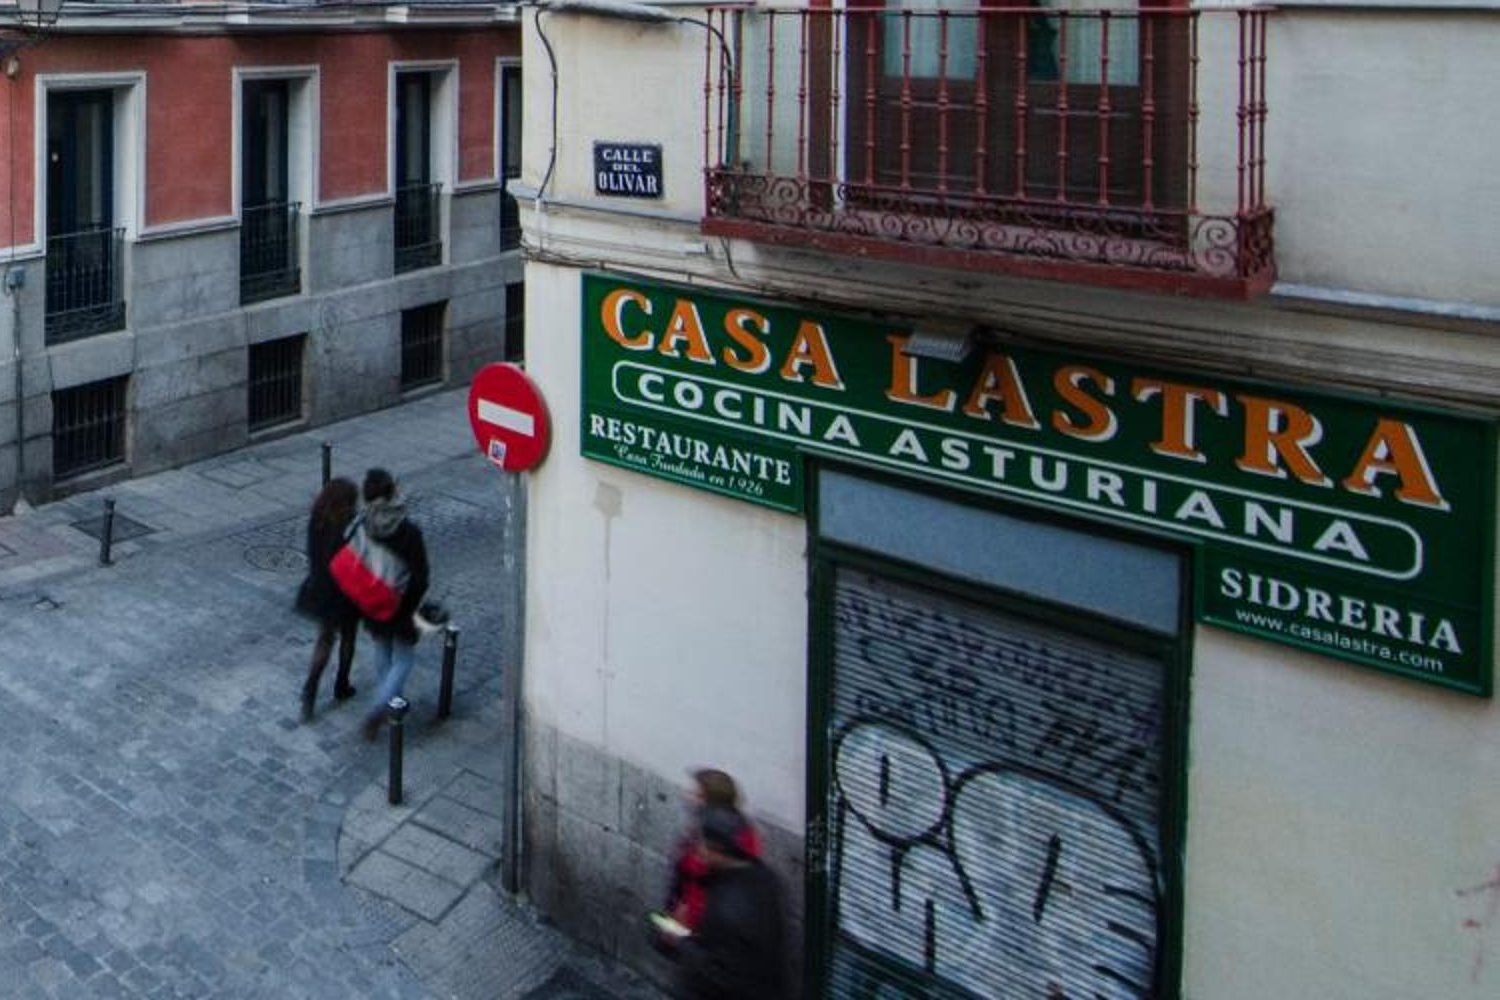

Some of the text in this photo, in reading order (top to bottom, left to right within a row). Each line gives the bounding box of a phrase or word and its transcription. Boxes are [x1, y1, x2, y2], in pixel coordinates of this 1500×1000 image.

[598, 171, 658, 193] OLIVAR
[603, 148, 654, 163] CALLE
[601, 287, 1452, 512] CASA LASTRA
[590, 413, 792, 486] RESTAURANTE
[613, 443, 647, 465] Casa
[650, 453, 706, 480] Fundada
[708, 473, 726, 486] en
[636, 373, 1371, 561] COCINA ASTURIANA
[1220, 567, 1464, 655] SIDRERIA
[1235, 607, 1445, 674] www.casalastra.com
